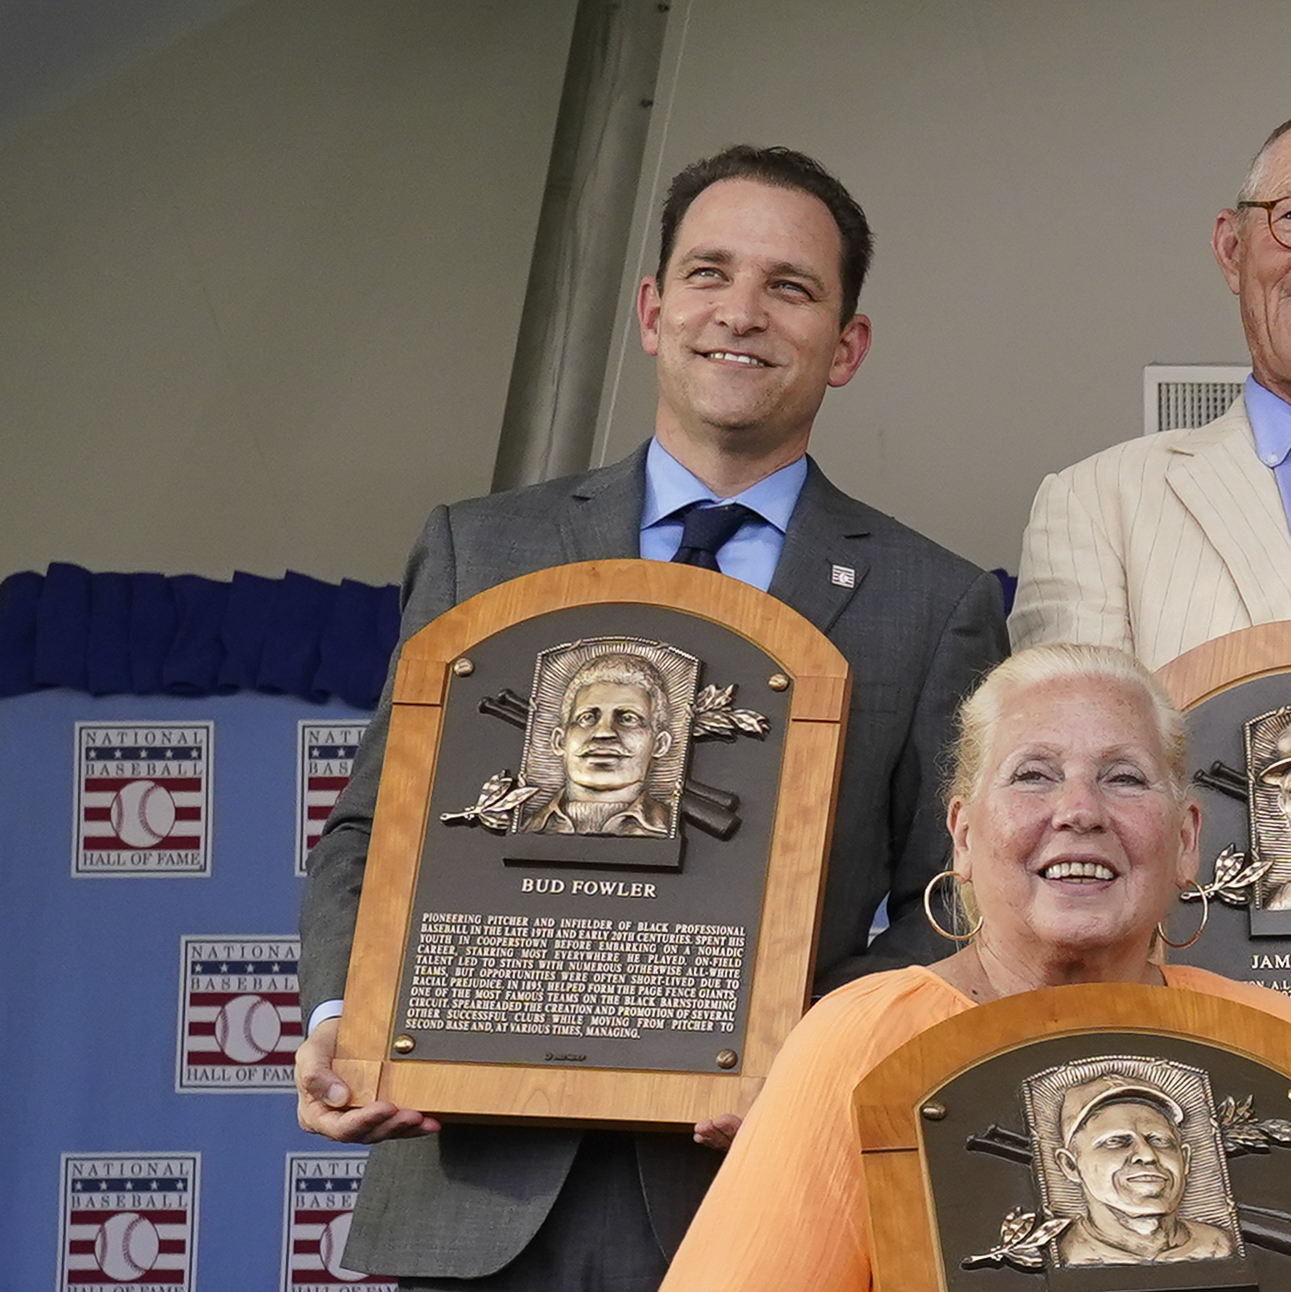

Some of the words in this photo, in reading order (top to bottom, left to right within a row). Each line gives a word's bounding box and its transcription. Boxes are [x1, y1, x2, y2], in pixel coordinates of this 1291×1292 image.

[86, 731, 202, 745] NATIONAL
[85, 762, 202, 776] BASEBALL
[84, 853, 126, 866] HALL
[131, 852, 152, 866] OF
[157, 852, 200, 866] FAME
[521, 878, 564, 892] BUD
[571, 880, 655, 896] FOWLER
[191, 946, 295, 959] NATIONA
[190, 977, 294, 990] BASEBAL
[187, 1068, 231, 1081] HALL
[236, 1068, 257, 1081] OF
[262, 1068, 295, 1081] FAM
[72, 1163, 189, 1176] NATIONAL
[72, 1194, 188, 1208] BASEBALL
